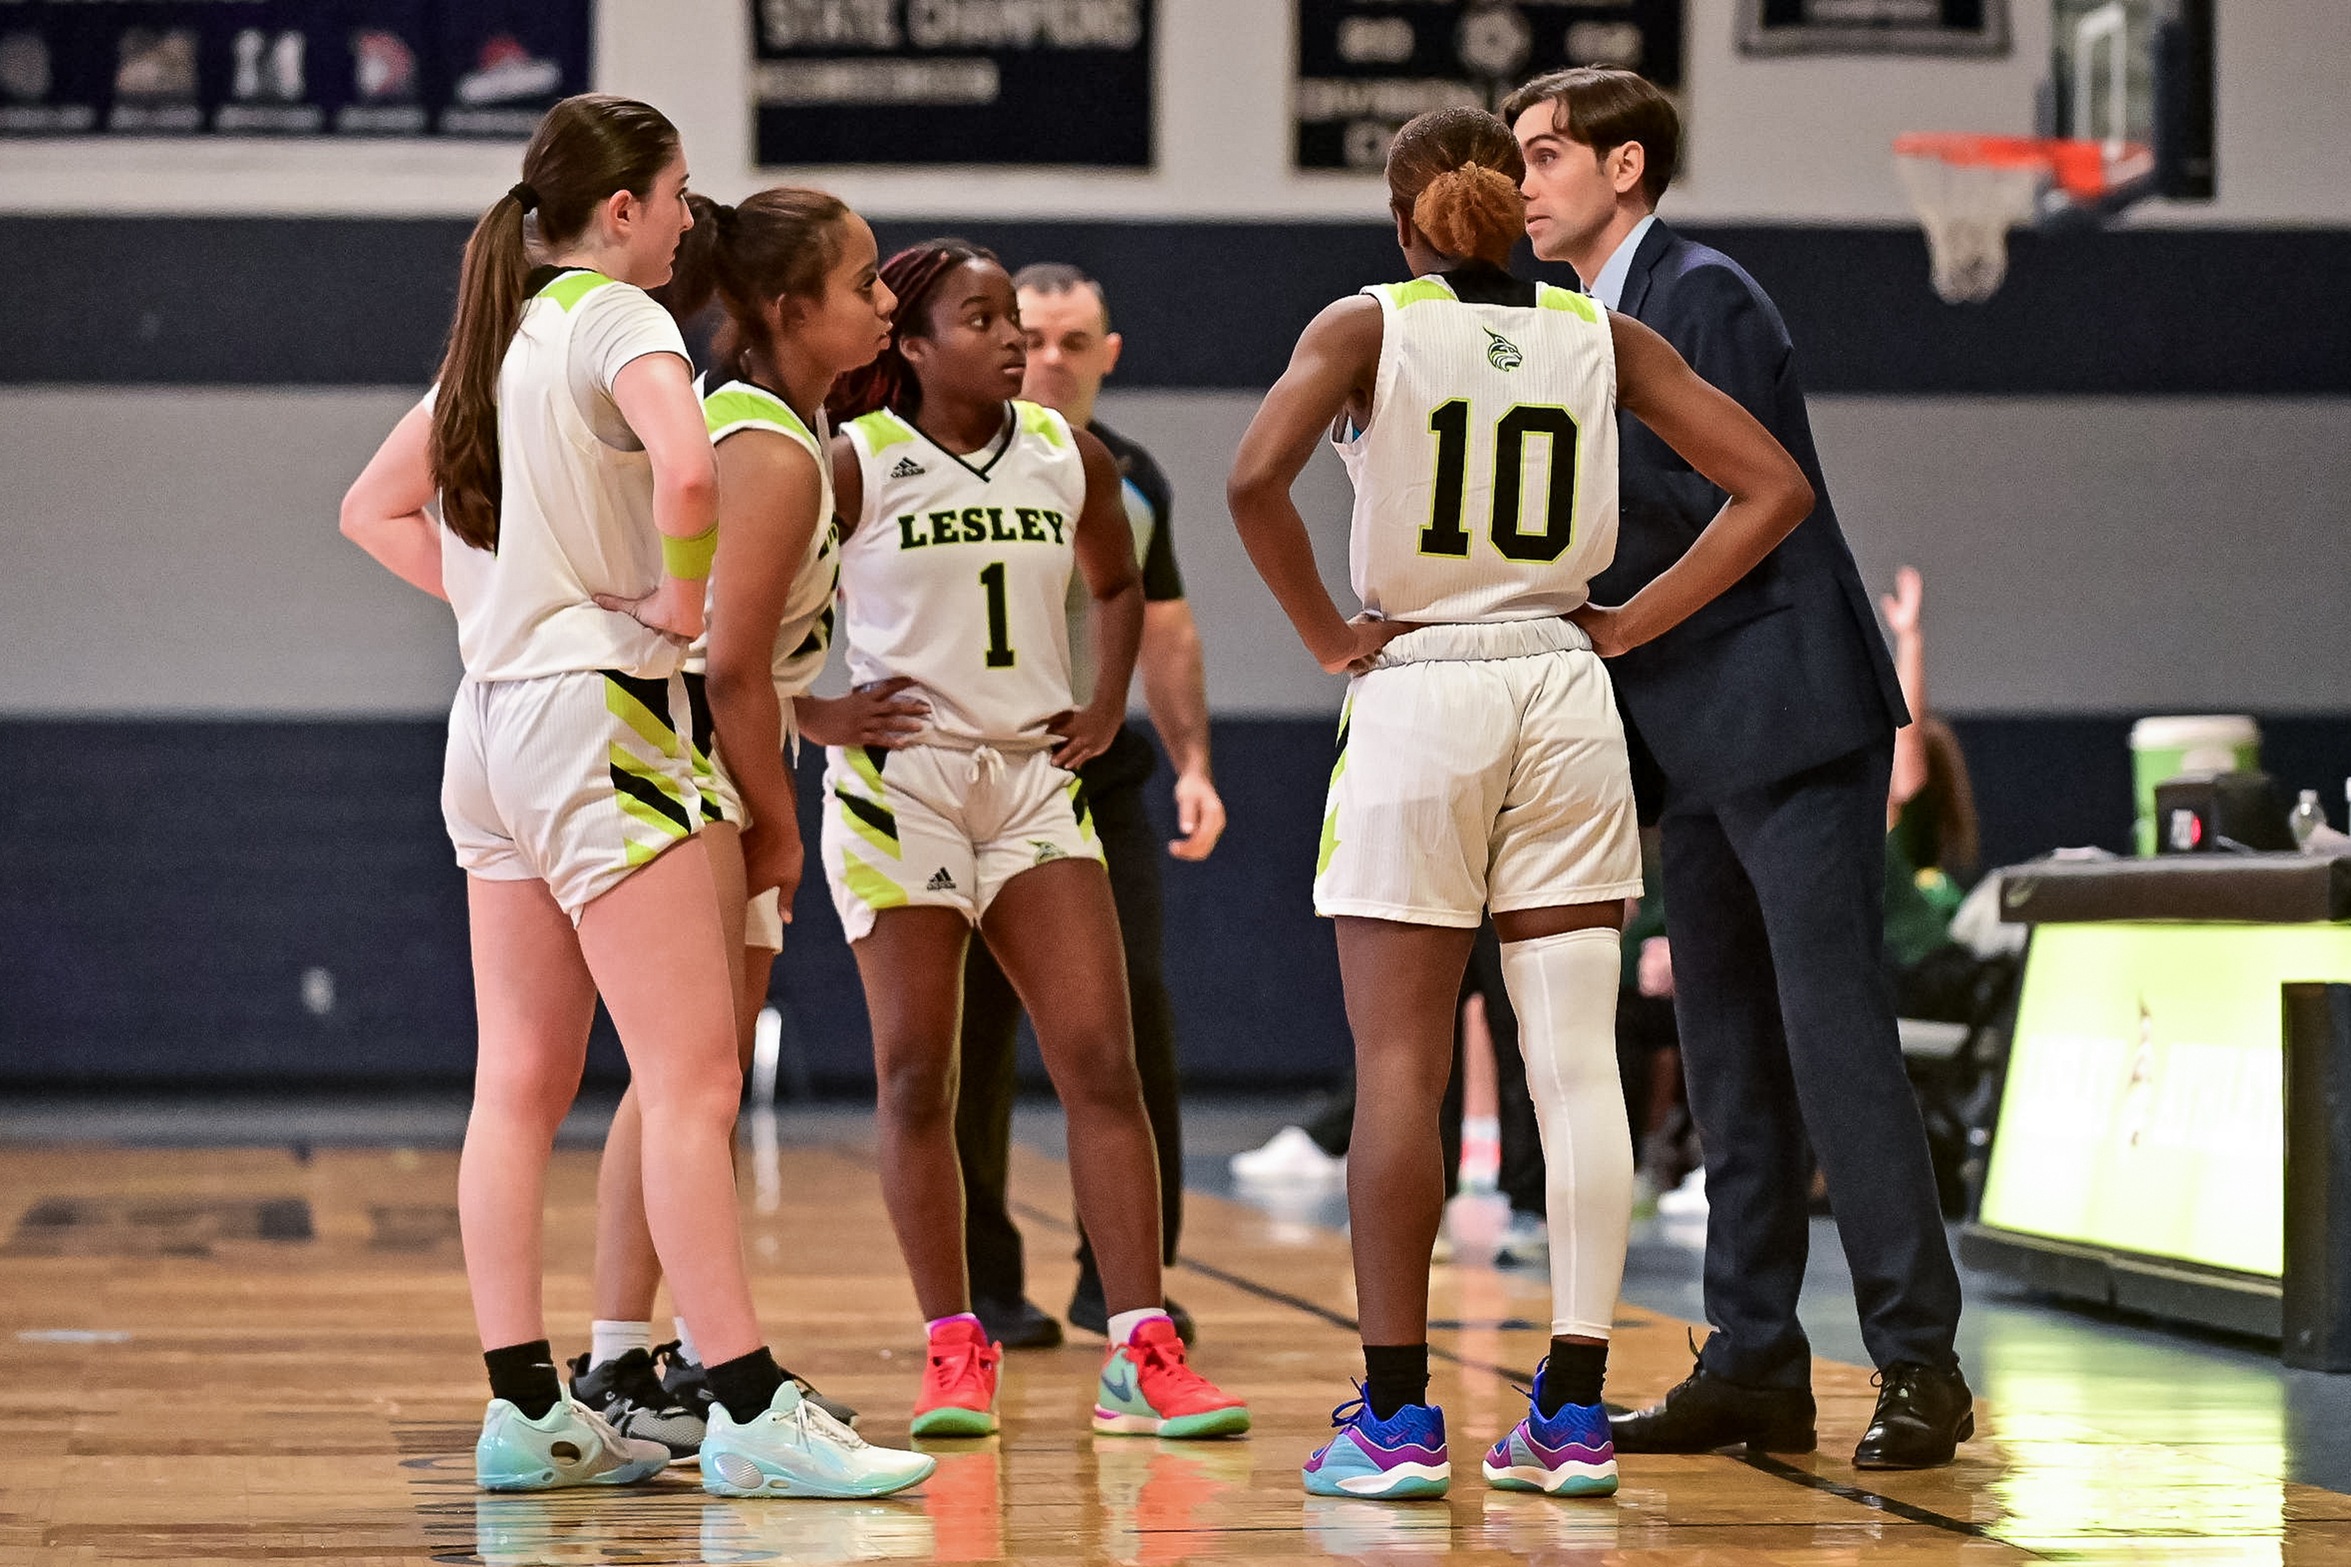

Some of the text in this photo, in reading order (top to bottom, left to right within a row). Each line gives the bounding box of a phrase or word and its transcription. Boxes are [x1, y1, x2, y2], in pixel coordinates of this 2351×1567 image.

[897, 506, 1065, 550] LESLEY
[1416, 397, 1582, 566] 10
[978, 560, 1017, 669] 1
